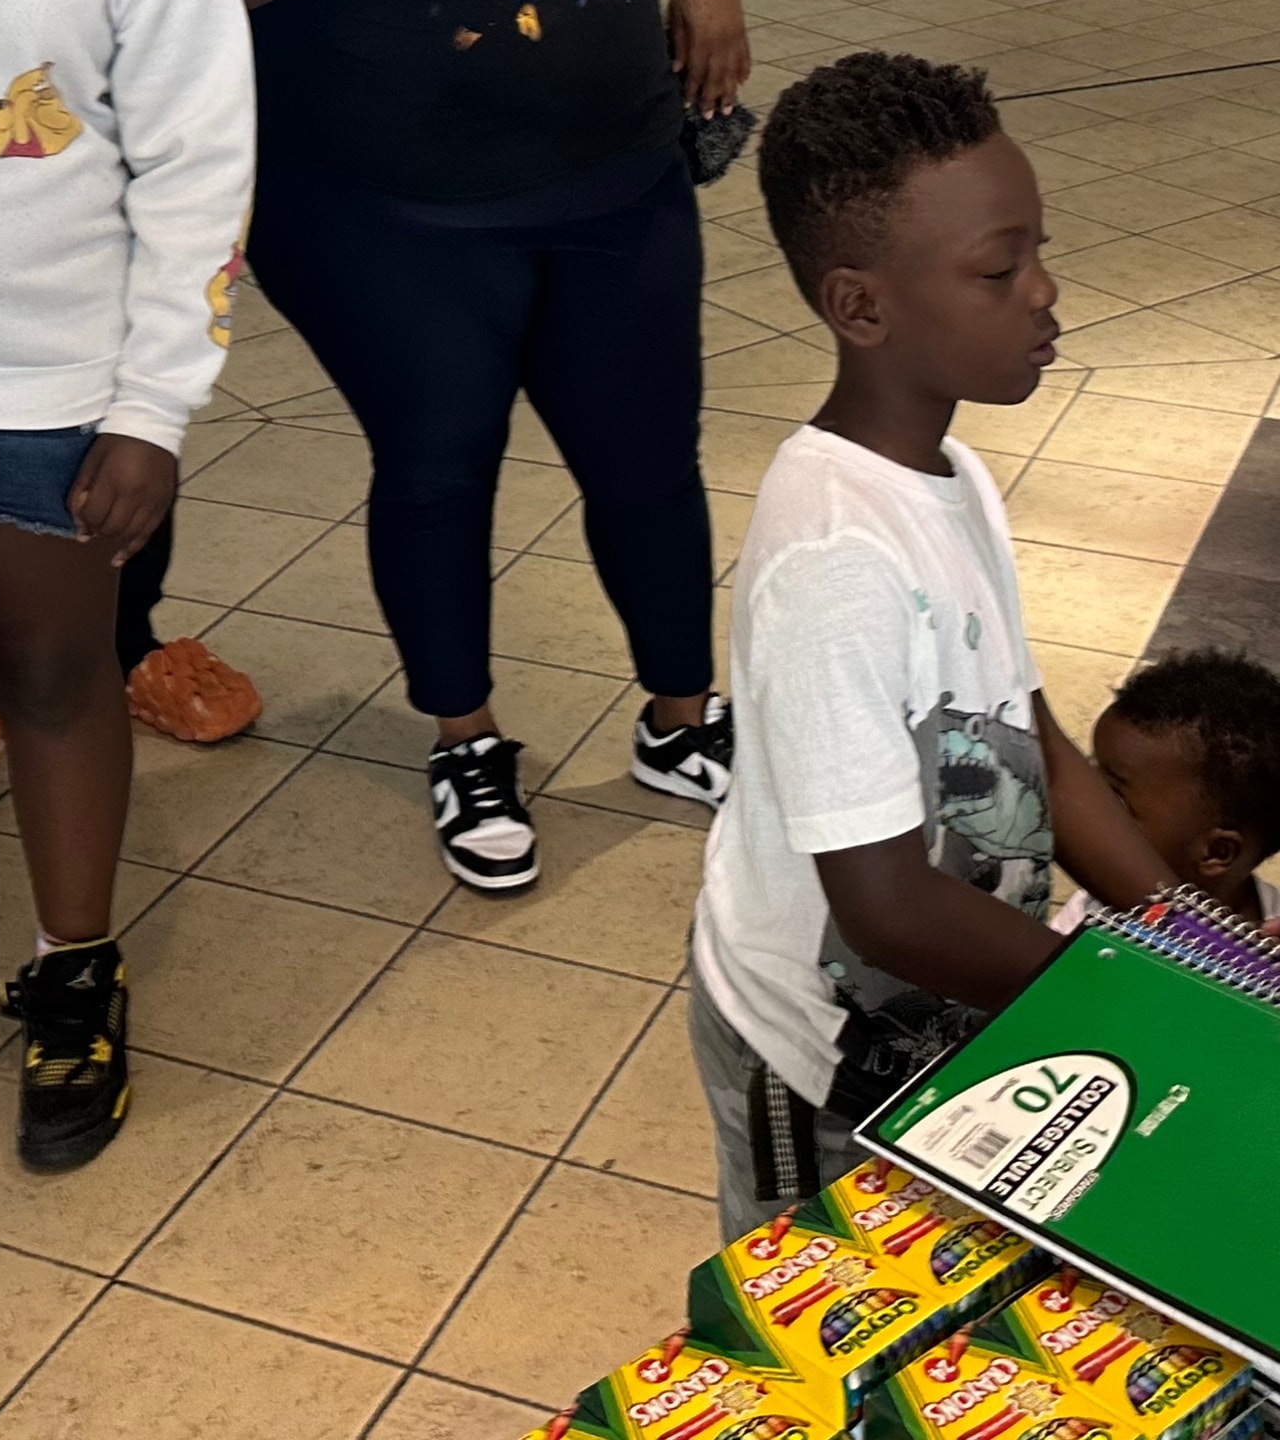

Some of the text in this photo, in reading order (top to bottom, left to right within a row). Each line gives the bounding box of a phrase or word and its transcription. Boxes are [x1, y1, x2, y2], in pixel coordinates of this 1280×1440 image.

[1012, 1064, 1081, 1113] 70
[989, 1079, 1111, 1196] COLLEGE RULE
[859, 1173, 883, 1192] 24
[1019, 1123, 1110, 1211] 1 SUBJECT
[852, 1176, 936, 1231] RAYONS
[742, 1237, 838, 1300] CRAYONS
[755, 1239, 780, 1258] 24
[949, 1231, 1022, 1283] Crayola
[838, 1296, 918, 1355] Crayola
[1039, 1289, 1130, 1354] CRAYONS
[1042, 1290, 1070, 1312] 24
[629, 1359, 730, 1427] CRAYONS
[639, 1361, 668, 1382] 24
[922, 1357, 1020, 1427] CRAYONS
[926, 1359, 957, 1382] 24
[1144, 1357, 1225, 1415] Crayola
